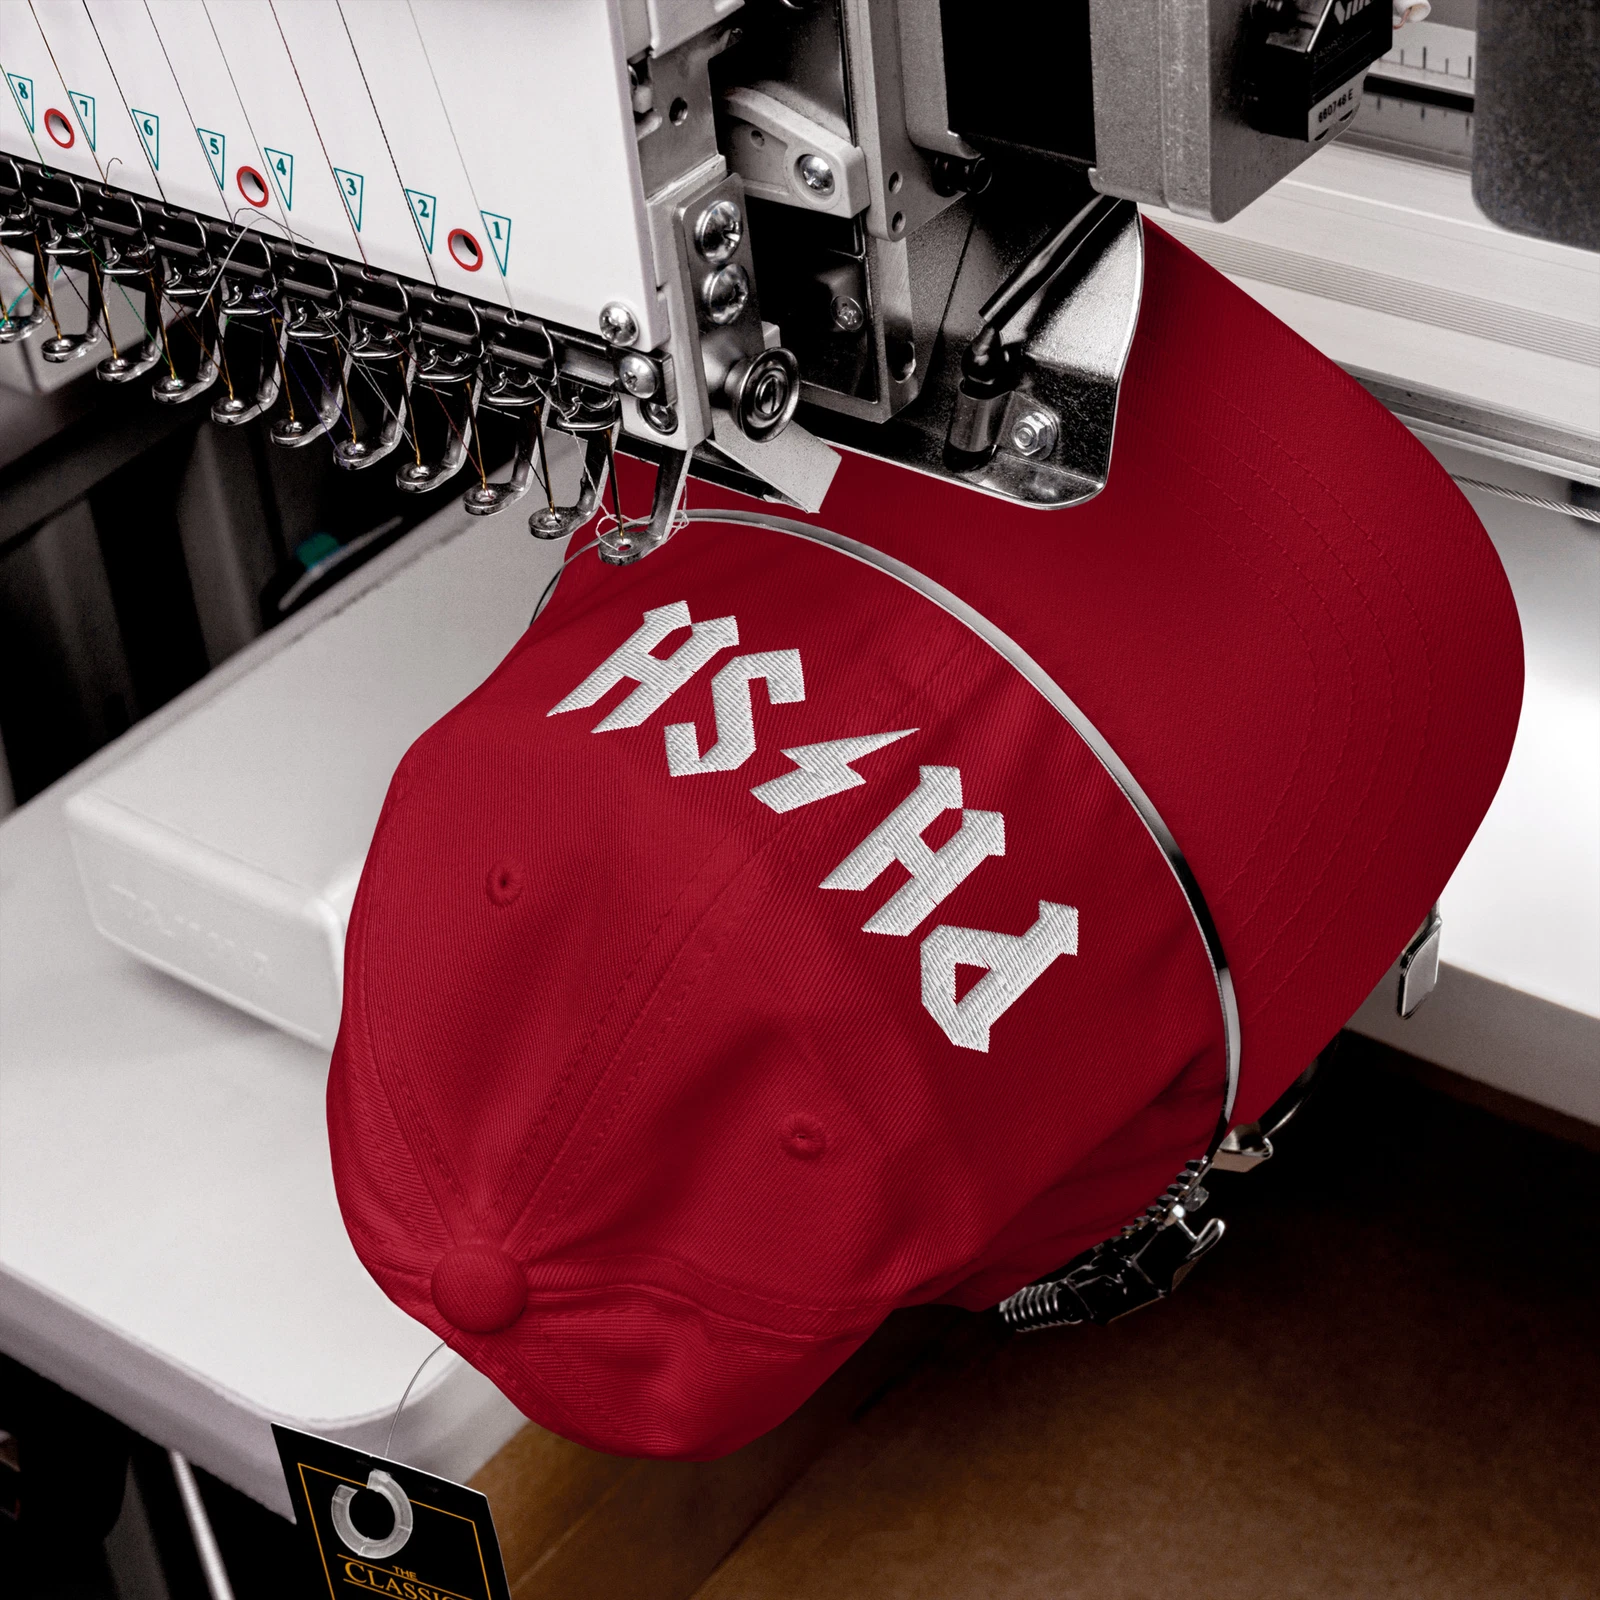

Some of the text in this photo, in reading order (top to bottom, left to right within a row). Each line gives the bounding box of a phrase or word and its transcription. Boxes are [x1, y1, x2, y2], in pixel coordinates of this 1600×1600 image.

[18, 82, 28, 99] 8
[79, 100, 89, 117] 7
[144, 119, 154, 136] 6
[210, 138, 220, 155] 5
[276, 158, 287, 176] 4
[346, 178, 357, 197] 3
[418, 199, 430, 218] 2
[493, 221, 503, 240] 1
[392, 1565, 417, 1580] THE
